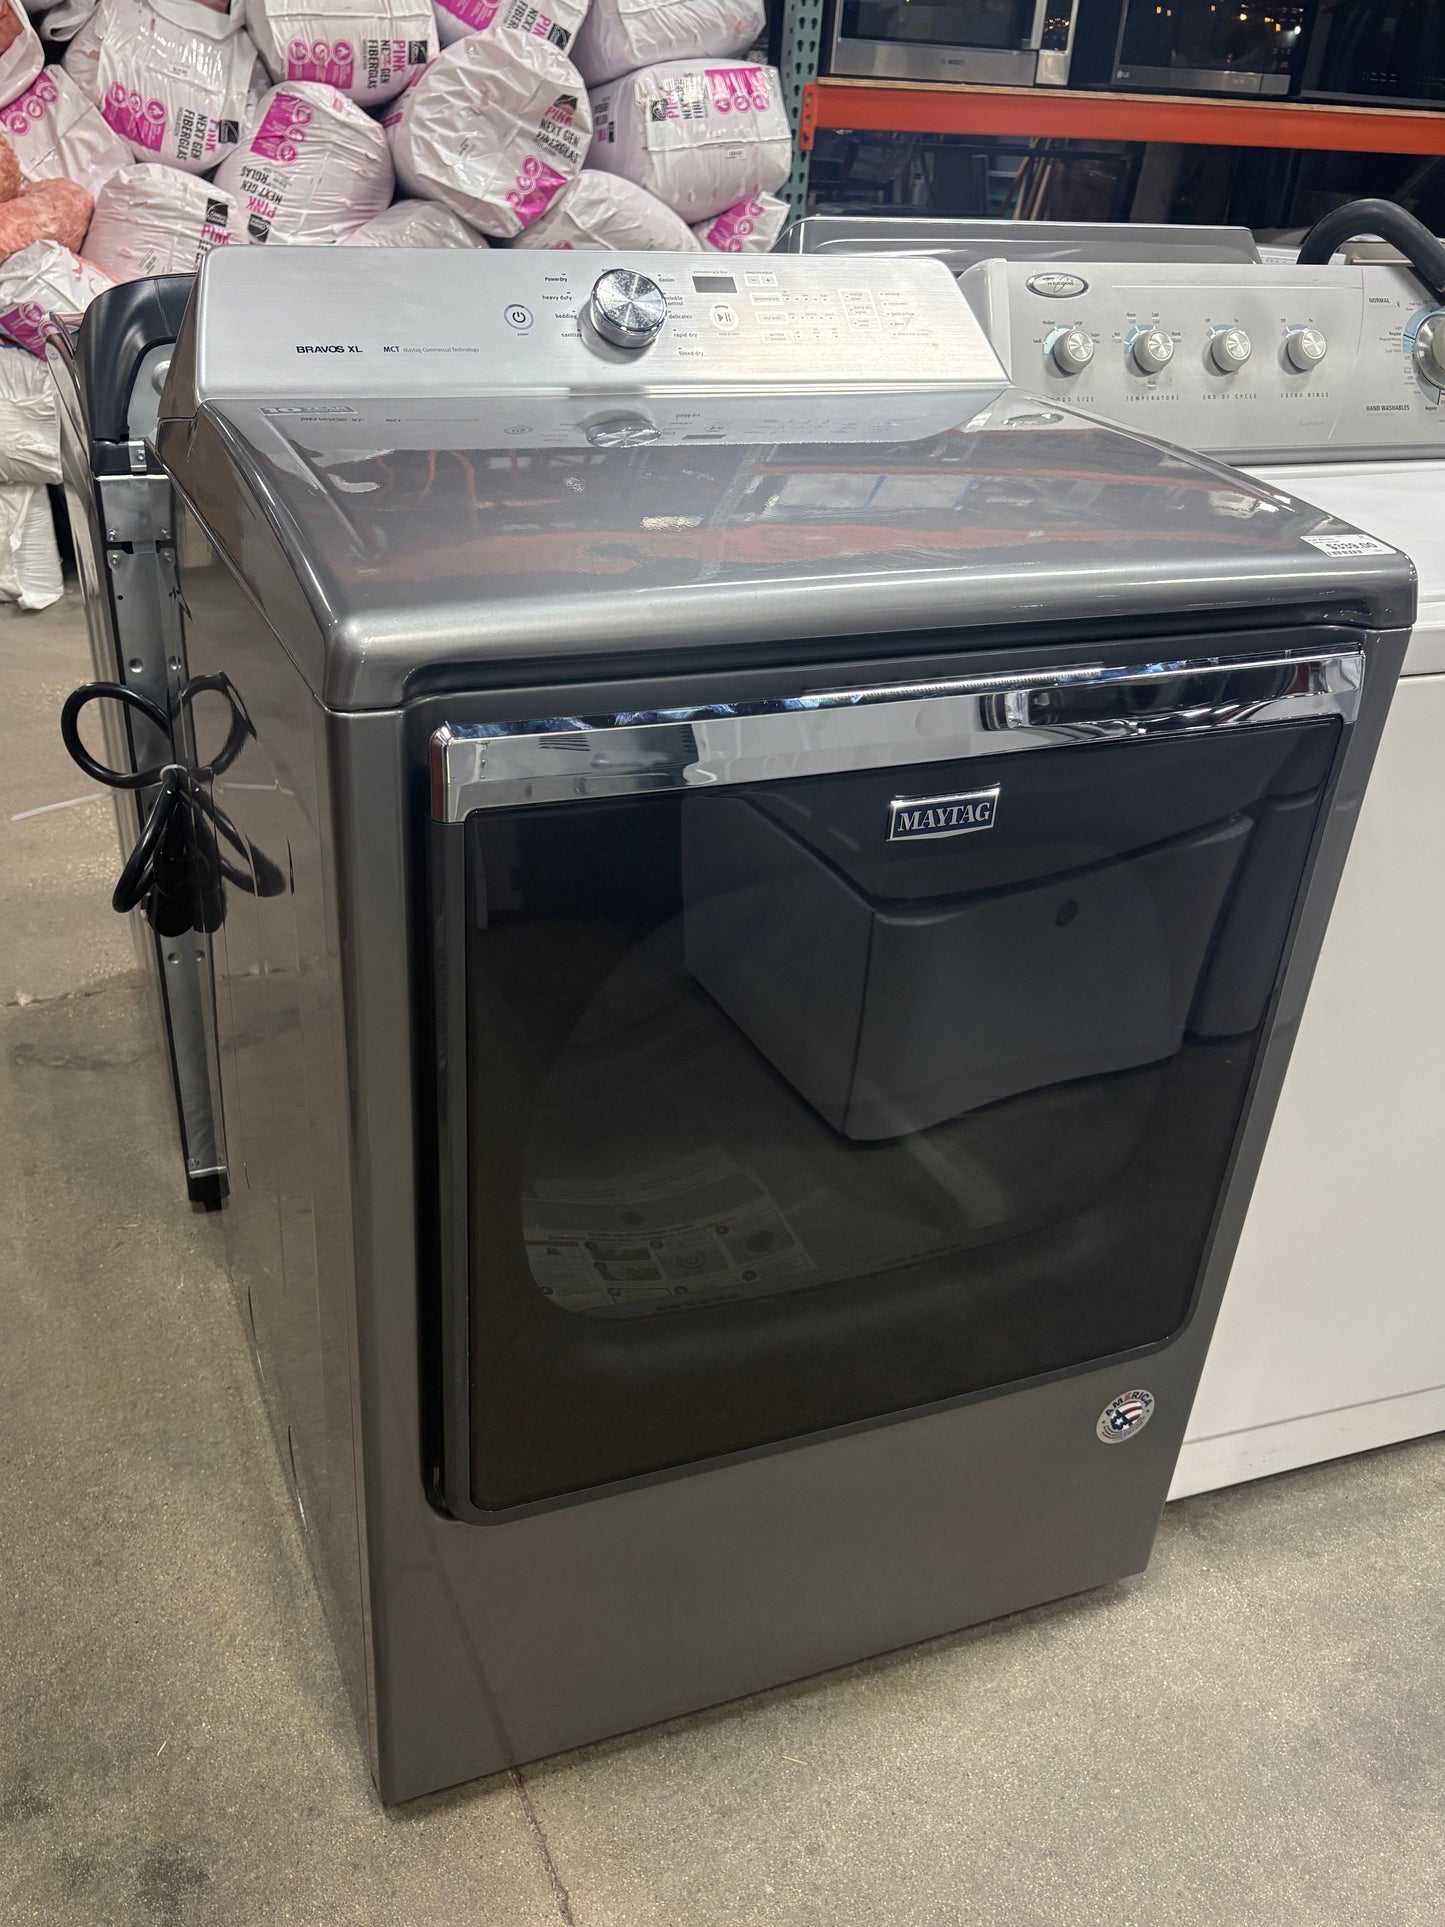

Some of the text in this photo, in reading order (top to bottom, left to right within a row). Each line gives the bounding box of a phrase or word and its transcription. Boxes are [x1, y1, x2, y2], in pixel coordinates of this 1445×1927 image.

[532, 14, 552, 38] PIN
[367, 40, 378, 89] FIBERGLAS
[392, 40, 406, 72] PINK
[176, 108, 196, 160] FIBERGLAS
[194, 114, 208, 141] NEXT
[205, 119, 219, 152] PINK
[240, 180, 284, 205] NEXT GEN
[246, 196, 278, 220] PINK
[201, 222, 232, 245] PINK
[296, 346, 345, 354] BRAVOS
[898, 802, 990, 831] MAYTAG
[1104, 1391, 1153, 1416] AMERICA
